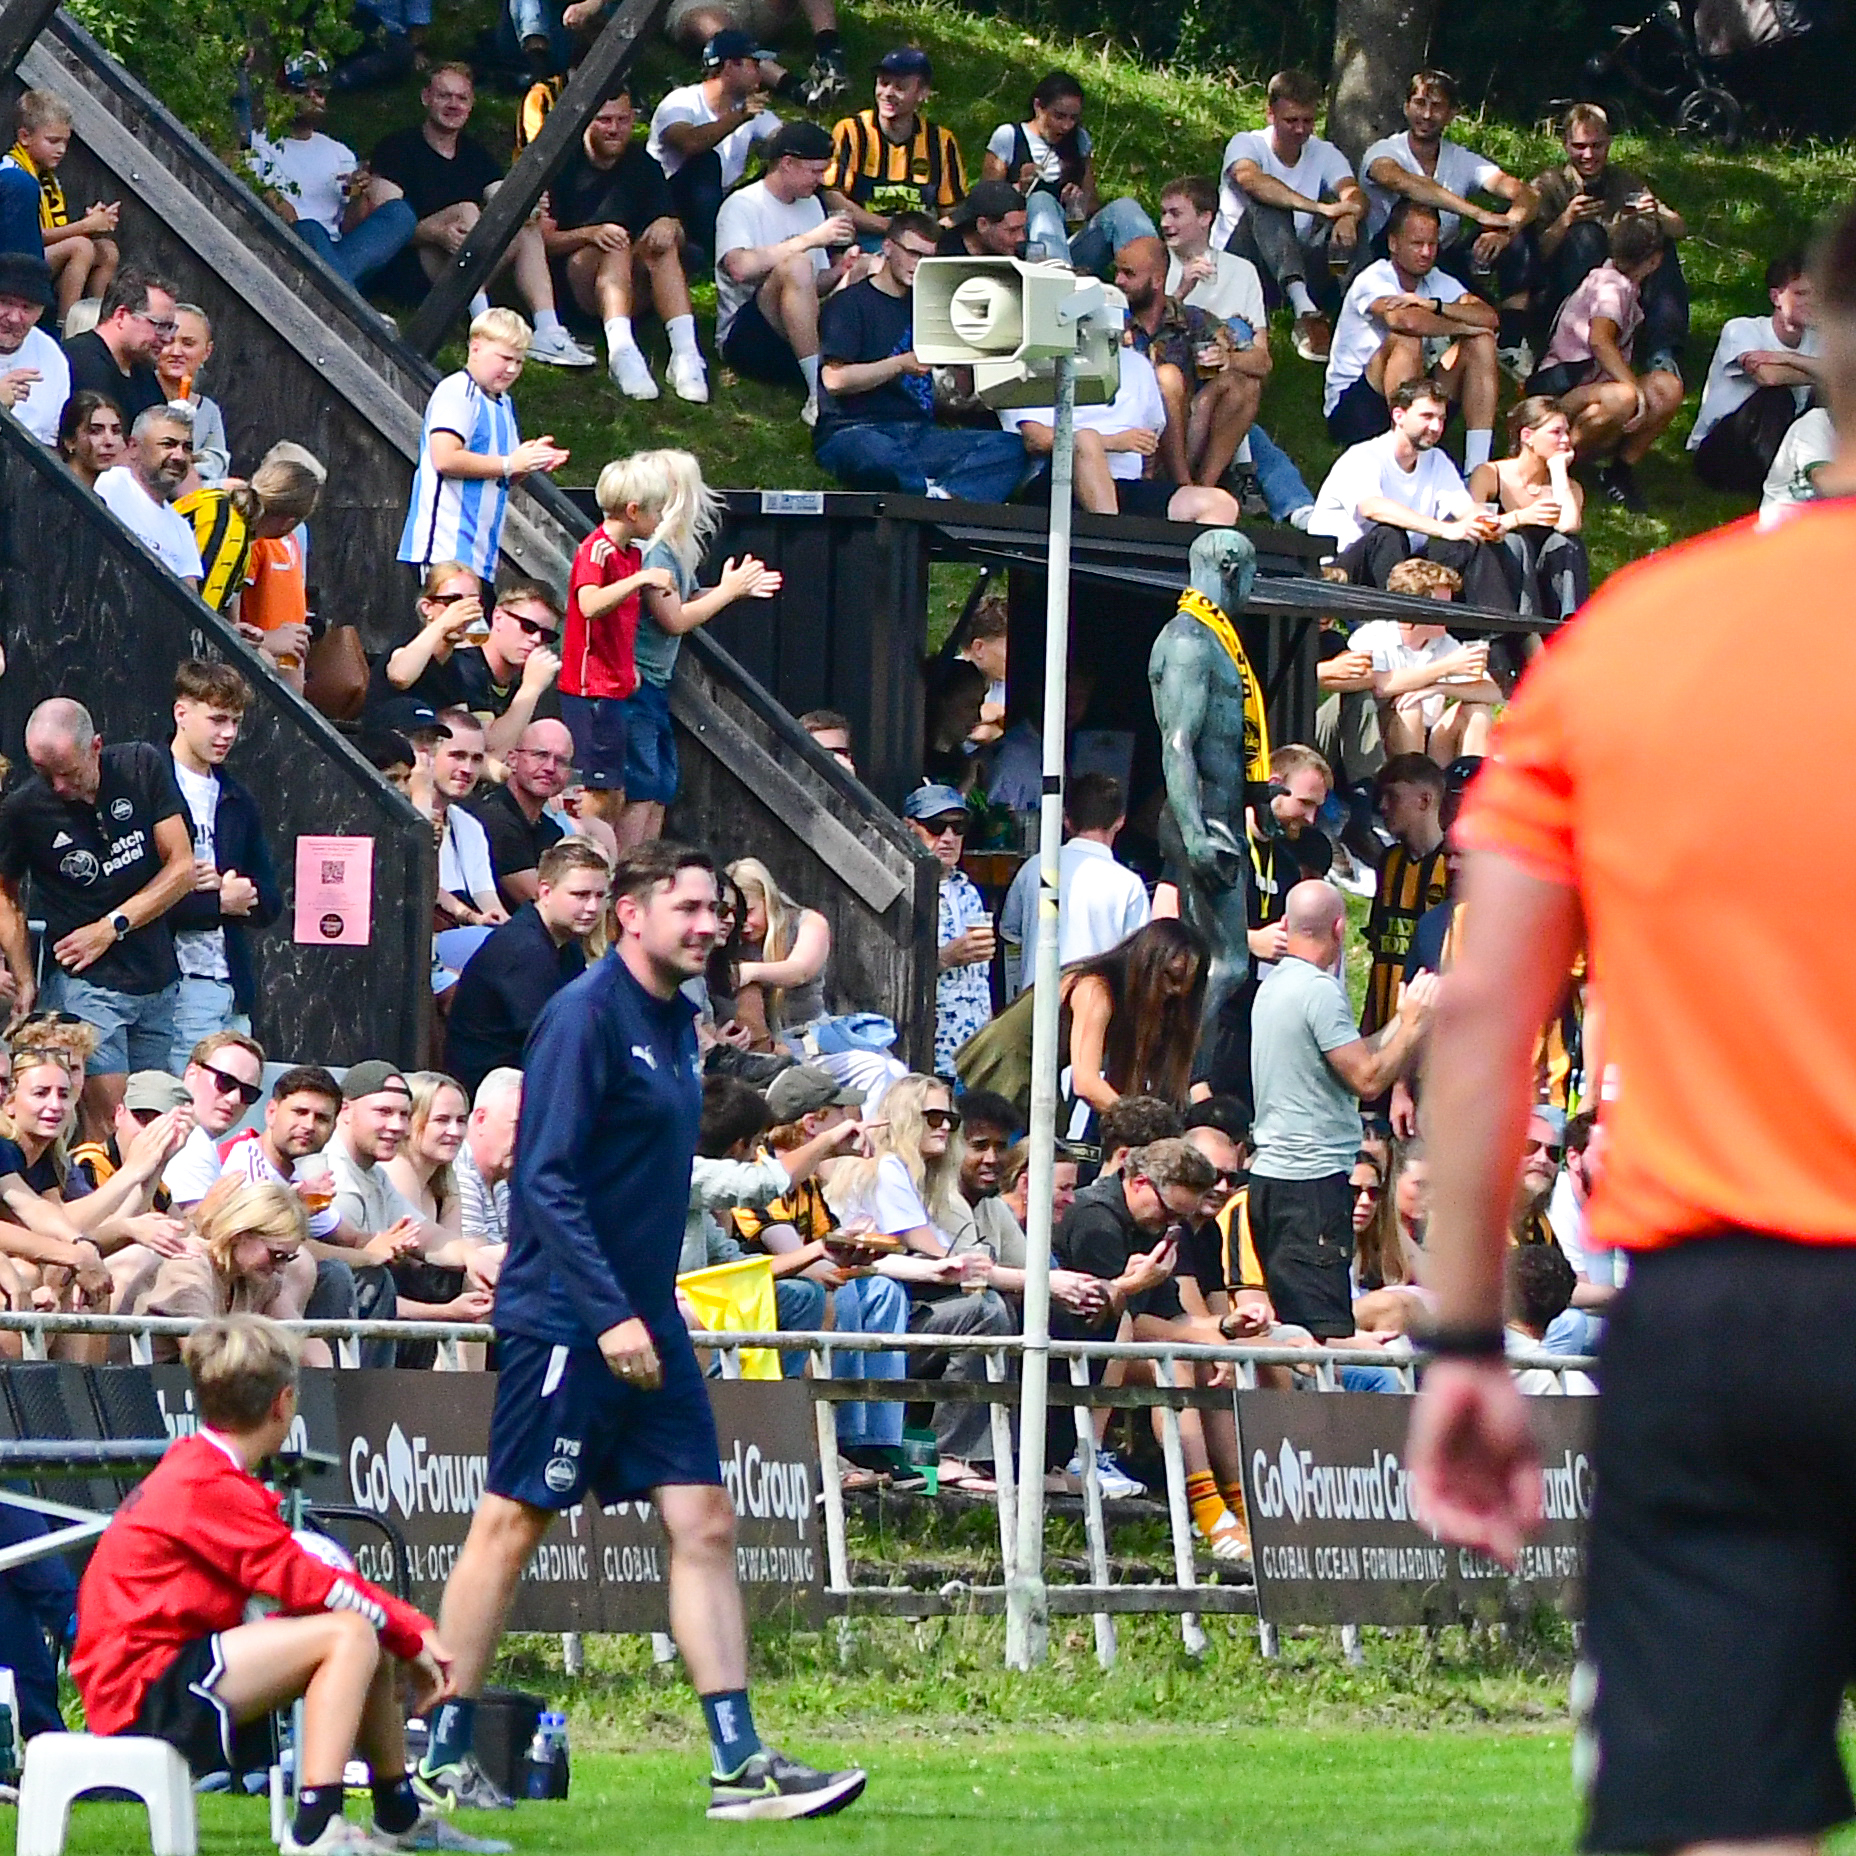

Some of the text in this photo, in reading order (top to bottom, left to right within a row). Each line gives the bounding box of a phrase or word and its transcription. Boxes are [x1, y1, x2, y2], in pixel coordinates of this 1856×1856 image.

[101, 845, 145, 877] padel
[554, 1436, 584, 1457] FYS
[350, 1435, 390, 1513] Go
[744, 1444, 810, 1540] Group
[1252, 1448, 1284, 1519] Go
[1298, 1448, 1385, 1521] Forward
[603, 1546, 661, 1582] GLOBAL
[1262, 1546, 1313, 1580] GLOBAL
[1314, 1546, 1361, 1580] OCEAN
[1362, 1547, 1448, 1580] FORWARDING
